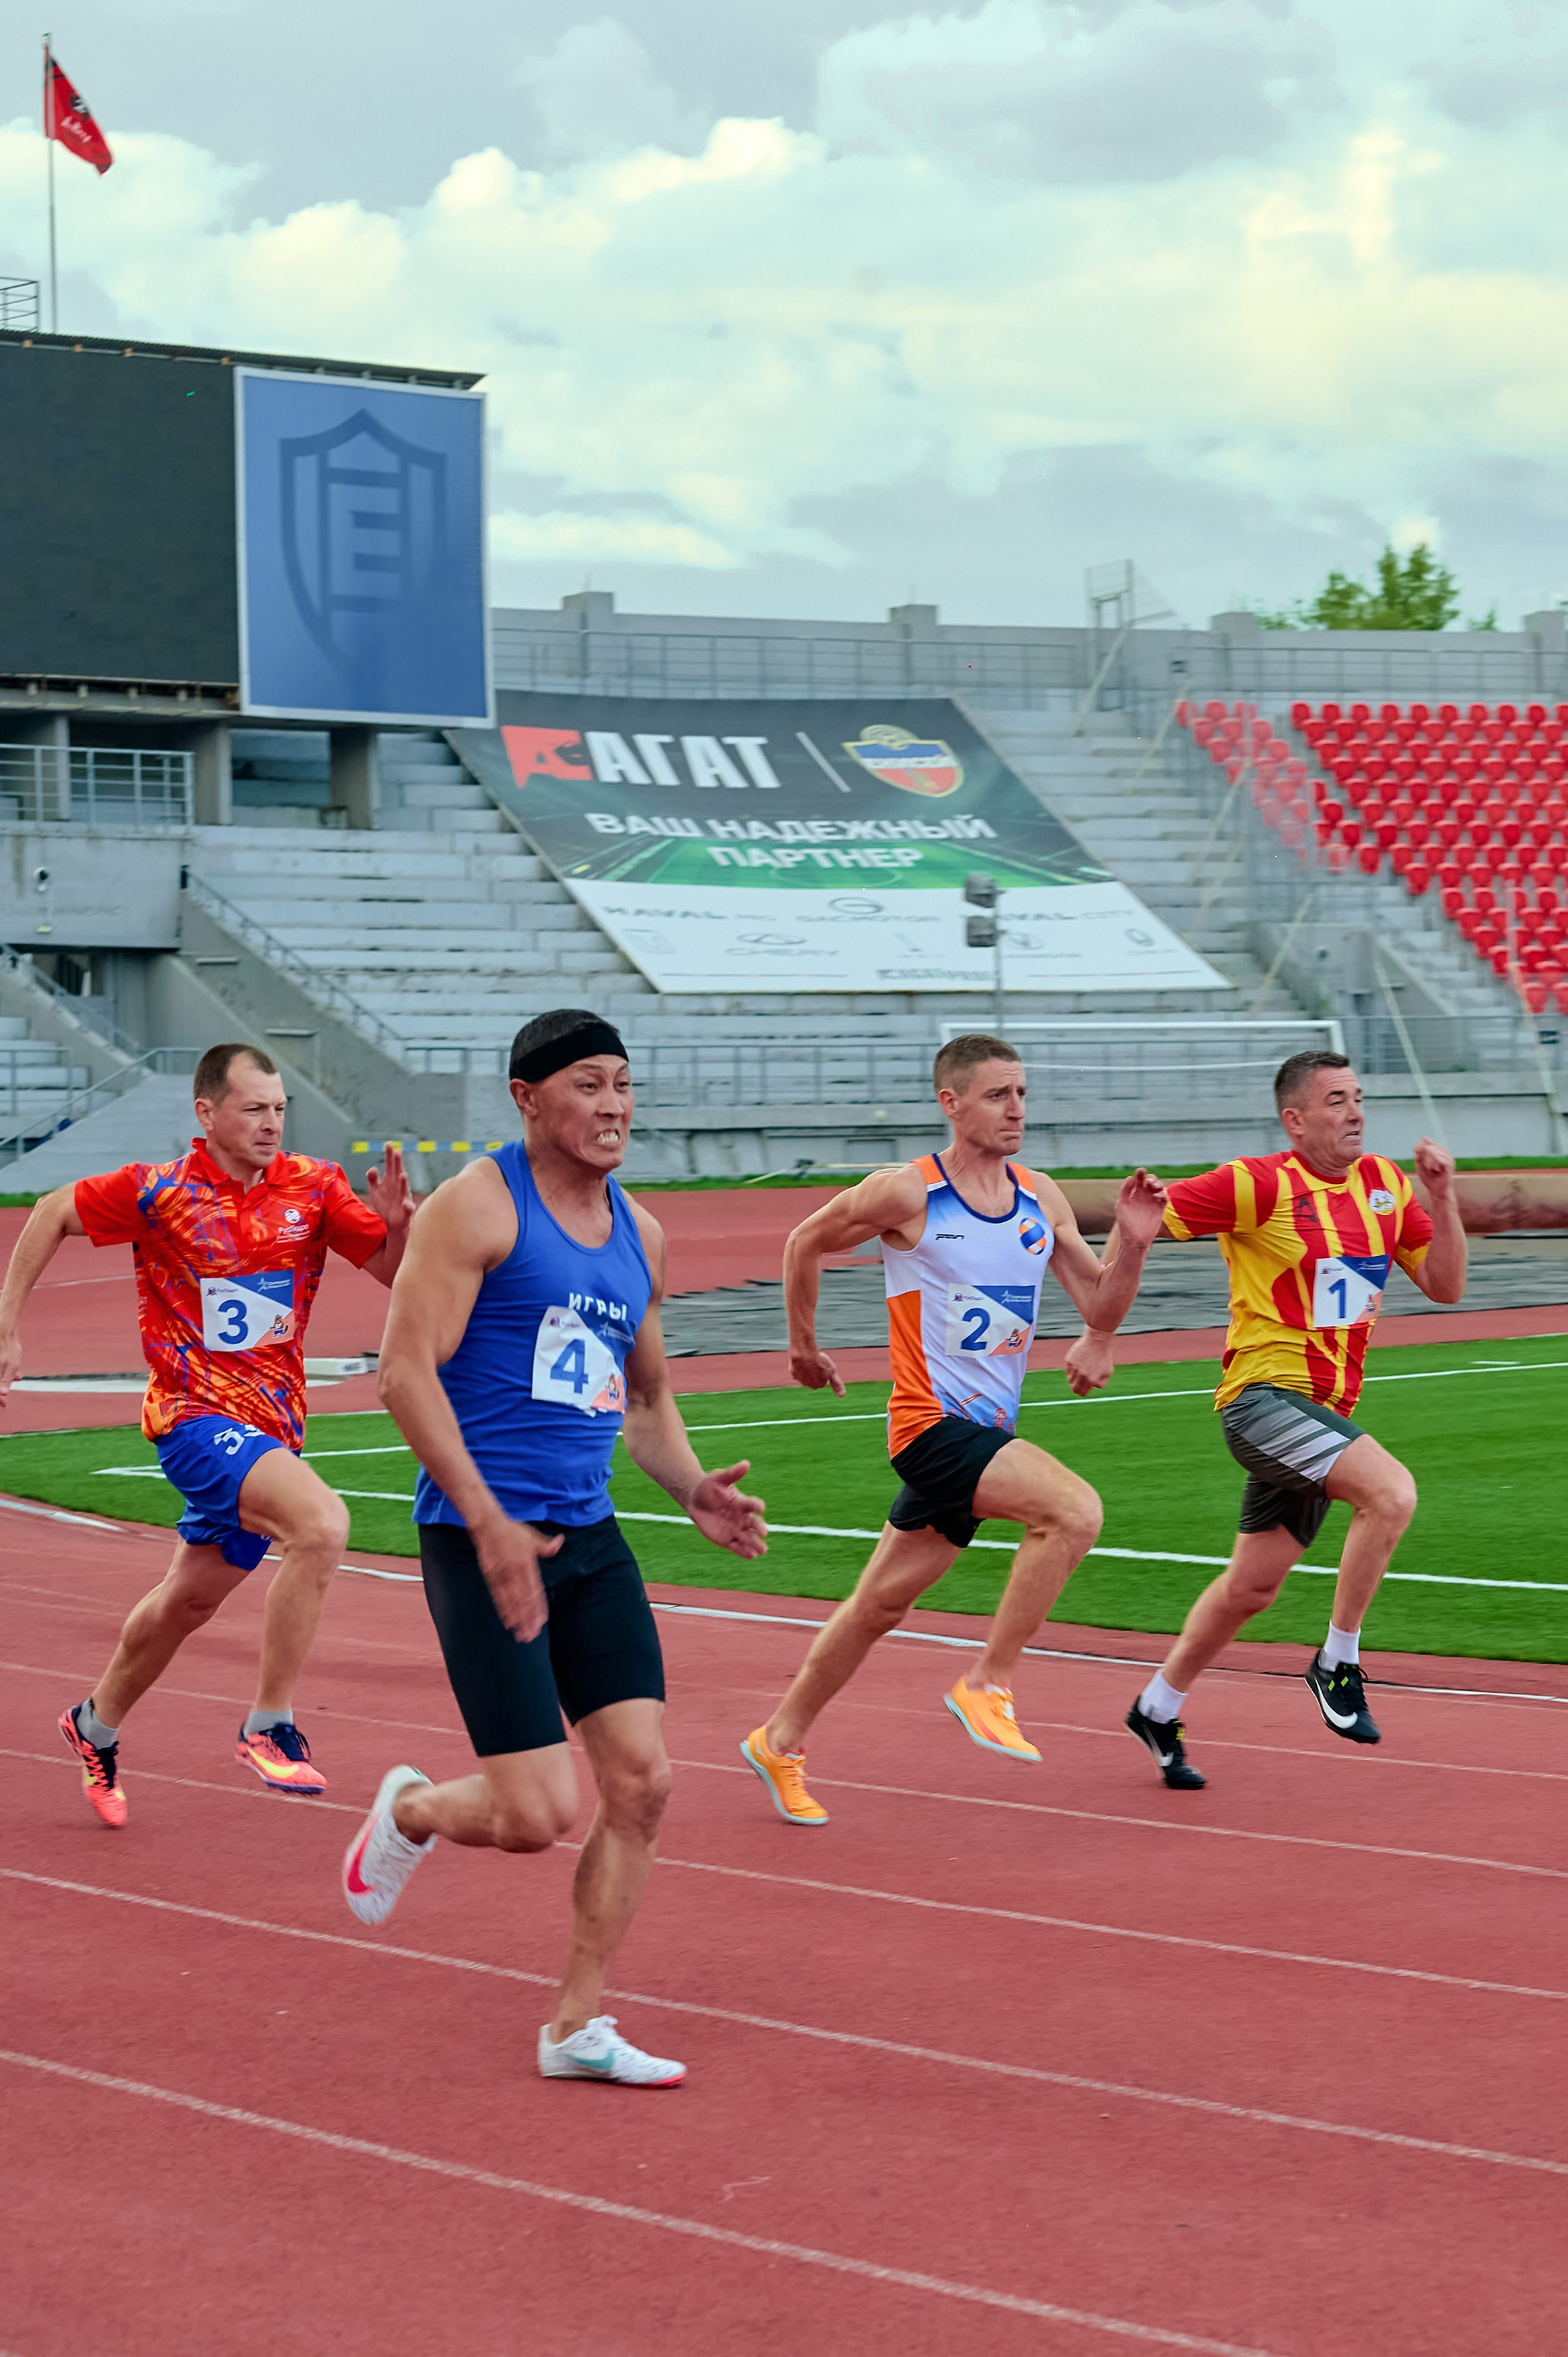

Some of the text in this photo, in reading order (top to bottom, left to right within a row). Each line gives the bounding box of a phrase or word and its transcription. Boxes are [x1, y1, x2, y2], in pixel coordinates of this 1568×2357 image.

[584, 731, 781, 789] АГАТ
[584, 812, 998, 843] ВАШ НАДЕЖНЫЙ
[707, 845, 924, 868] ПАРТНЕР
[568, 1292, 627, 1321] ИГРЫ
[1328, 1278, 1347, 1319] 1
[217, 1300, 248, 1345] 3
[961, 1308, 990, 1351] 2
[550, 1339, 588, 1394] 4
